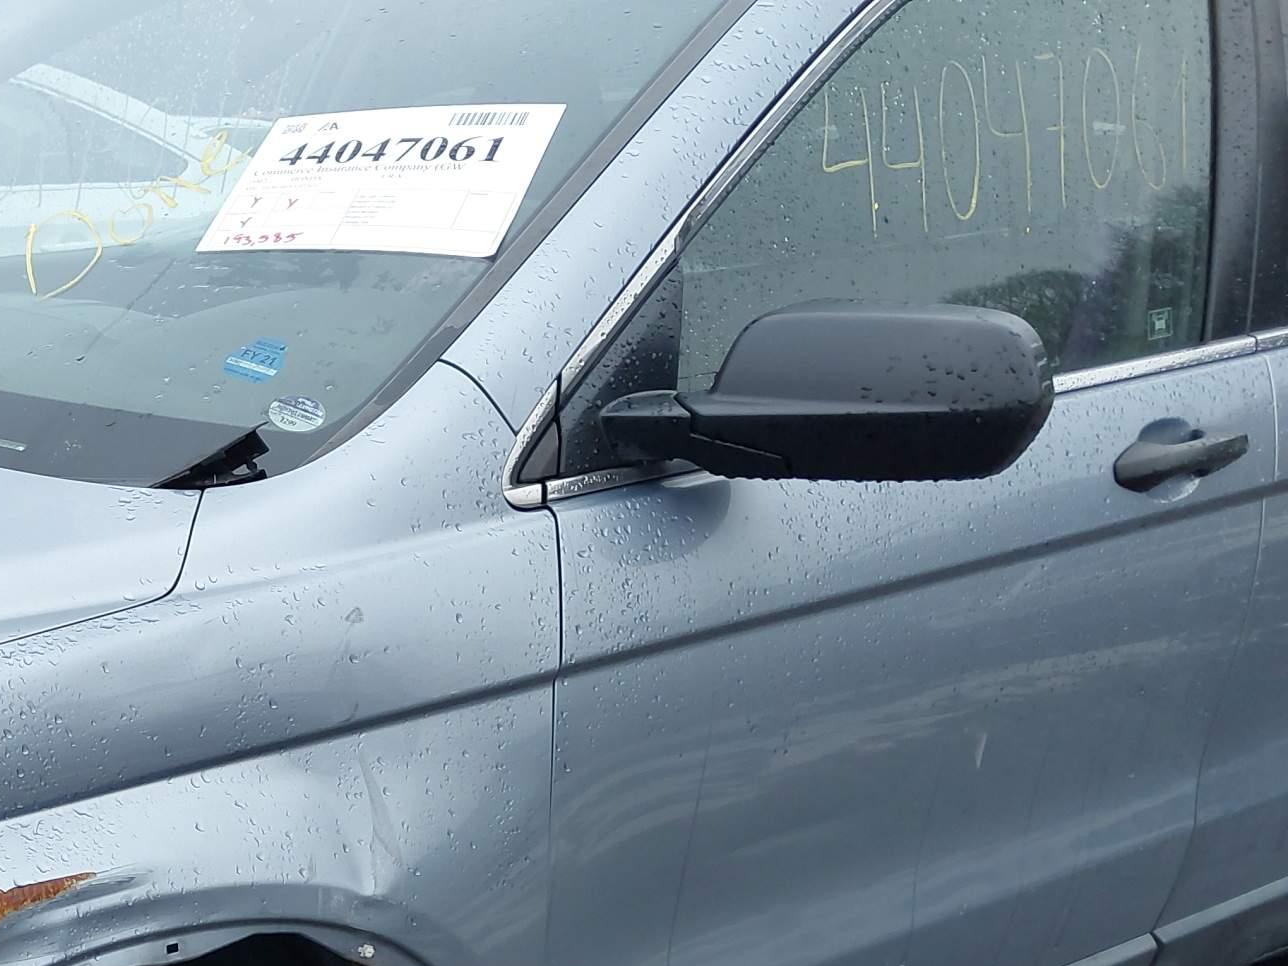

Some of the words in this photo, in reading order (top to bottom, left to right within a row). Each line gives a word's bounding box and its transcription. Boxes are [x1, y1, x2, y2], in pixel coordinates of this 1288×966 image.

[279, 136, 505, 167] 44047061
[822, 42, 1188, 239] 44047061
[241, 349, 261, 360] FY
[259, 354, 278, 367] 21
